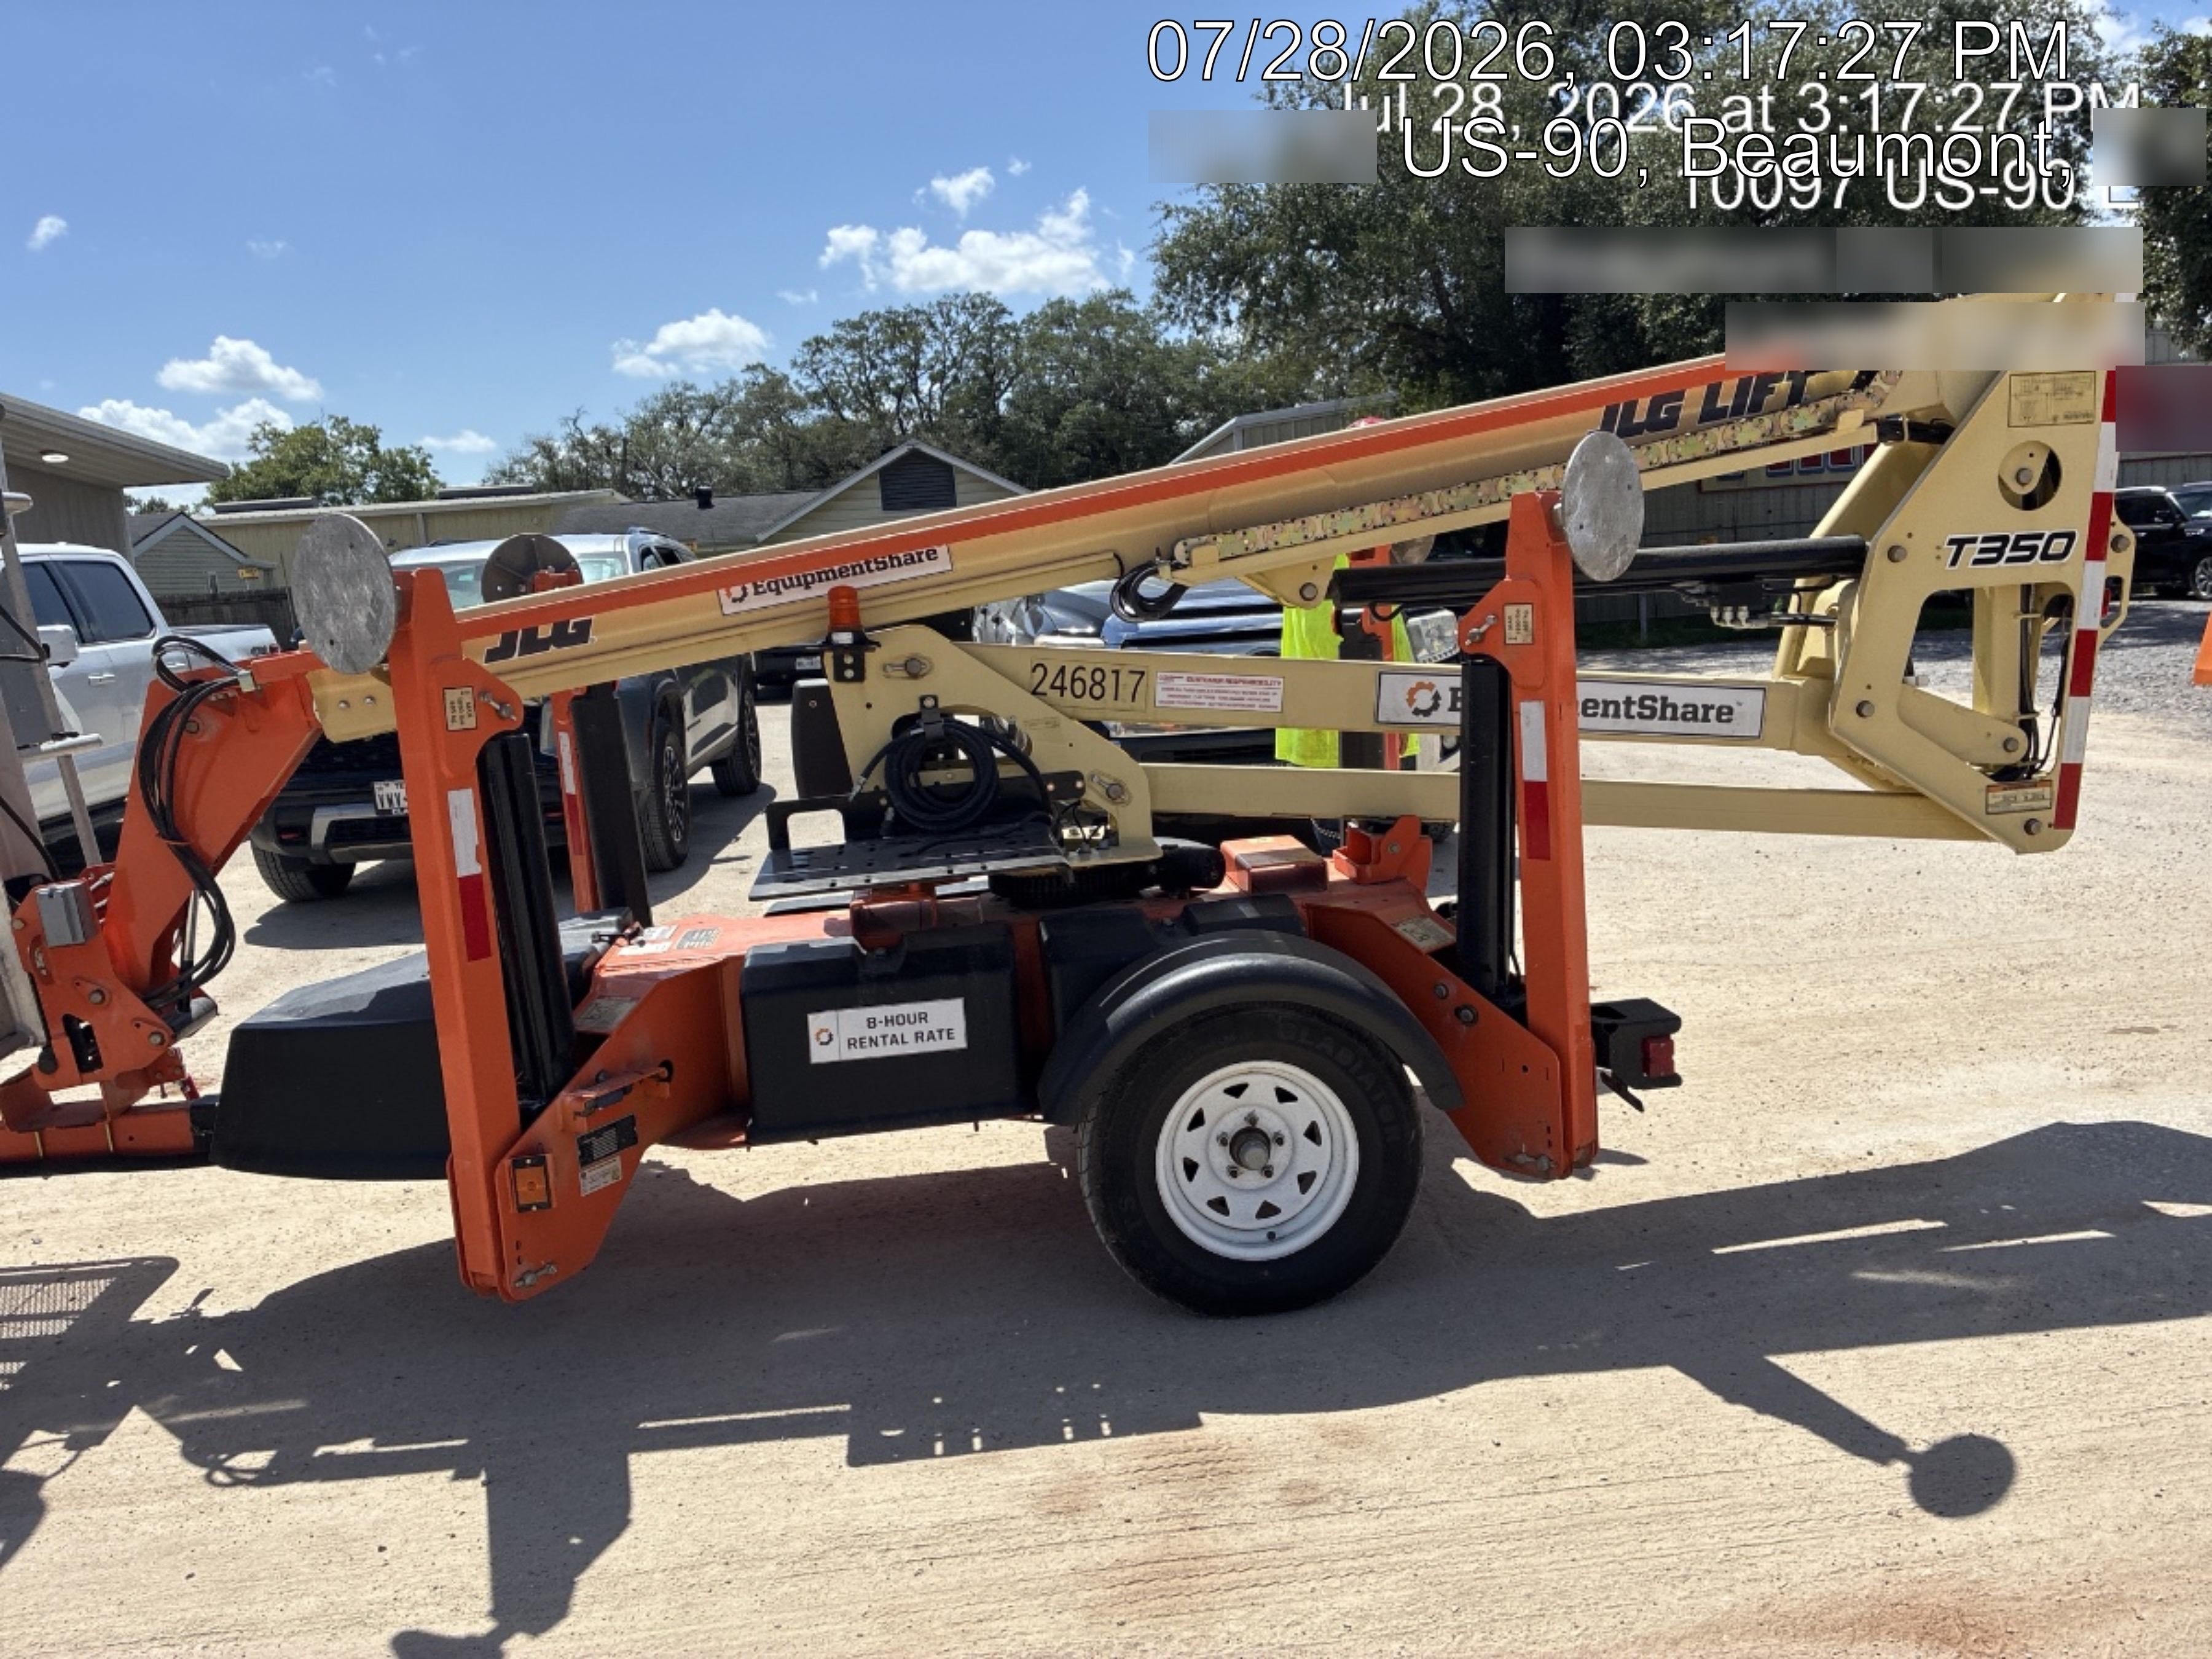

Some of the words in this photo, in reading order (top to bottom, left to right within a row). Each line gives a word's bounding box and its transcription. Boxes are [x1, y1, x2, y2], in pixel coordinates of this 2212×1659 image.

[1945, 530, 2077, 570] T350
[753, 547, 938, 596] EquipmentShare
[484, 616, 594, 665] JLG
[1031, 662, 1146, 703] 246817
[1448, 686, 1734, 723] EentShare
[847, 1033, 909, 1050] RENTAL
[914, 1028, 955, 1044] RATE
[866, 1011, 929, 1029] 8-HOUR
